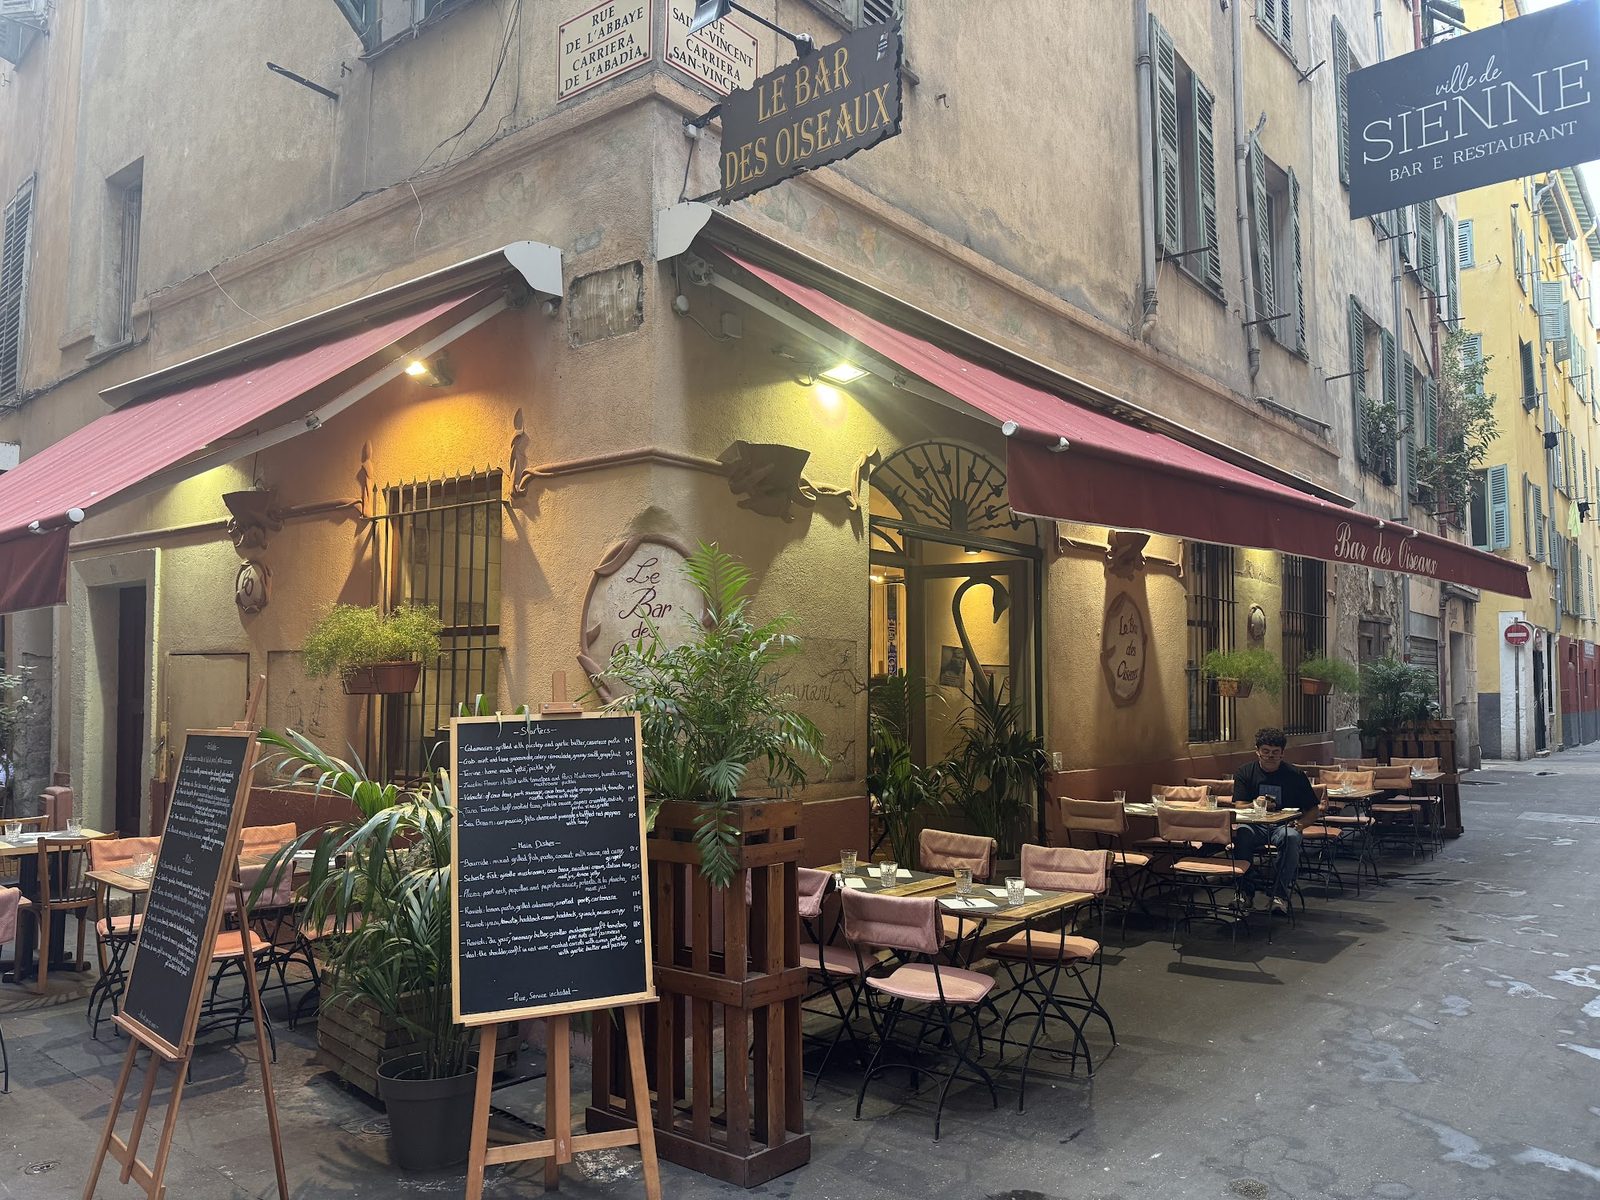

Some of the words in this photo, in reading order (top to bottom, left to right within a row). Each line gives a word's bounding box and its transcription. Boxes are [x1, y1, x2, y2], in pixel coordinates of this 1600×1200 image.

[565, 37, 581, 54] DE
[587, 7, 644, 47] L'ABBAYE
[591, 6, 615, 27] RUE
[672, 7, 753, 68] SAIT-VINCENT
[572, 33, 635, 72] CARRIERA
[686, 38, 741, 82] CARRIERA
[1435, 62, 1477, 96] ville
[1479, 54, 1502, 83] de
[565, 74, 580, 91] DE
[758, 74, 787, 123] LE
[794, 48, 852, 108] BAR
[1362, 59, 1591, 165] SIENNE
[724, 138, 769, 191] DES
[775, 83, 893, 167] OISEAUX
[1389, 162, 1423, 182] BAR
[1432, 155, 1444, 170] E
[1453, 120, 1578, 164] RESTAURANT
[626, 557, 660, 584] Le
[1334, 522, 1369, 561] Bar
[1372, 532, 1394, 565] des
[1398, 537, 1439, 576] Oiseaux
[618, 586, 672, 619] Bar
